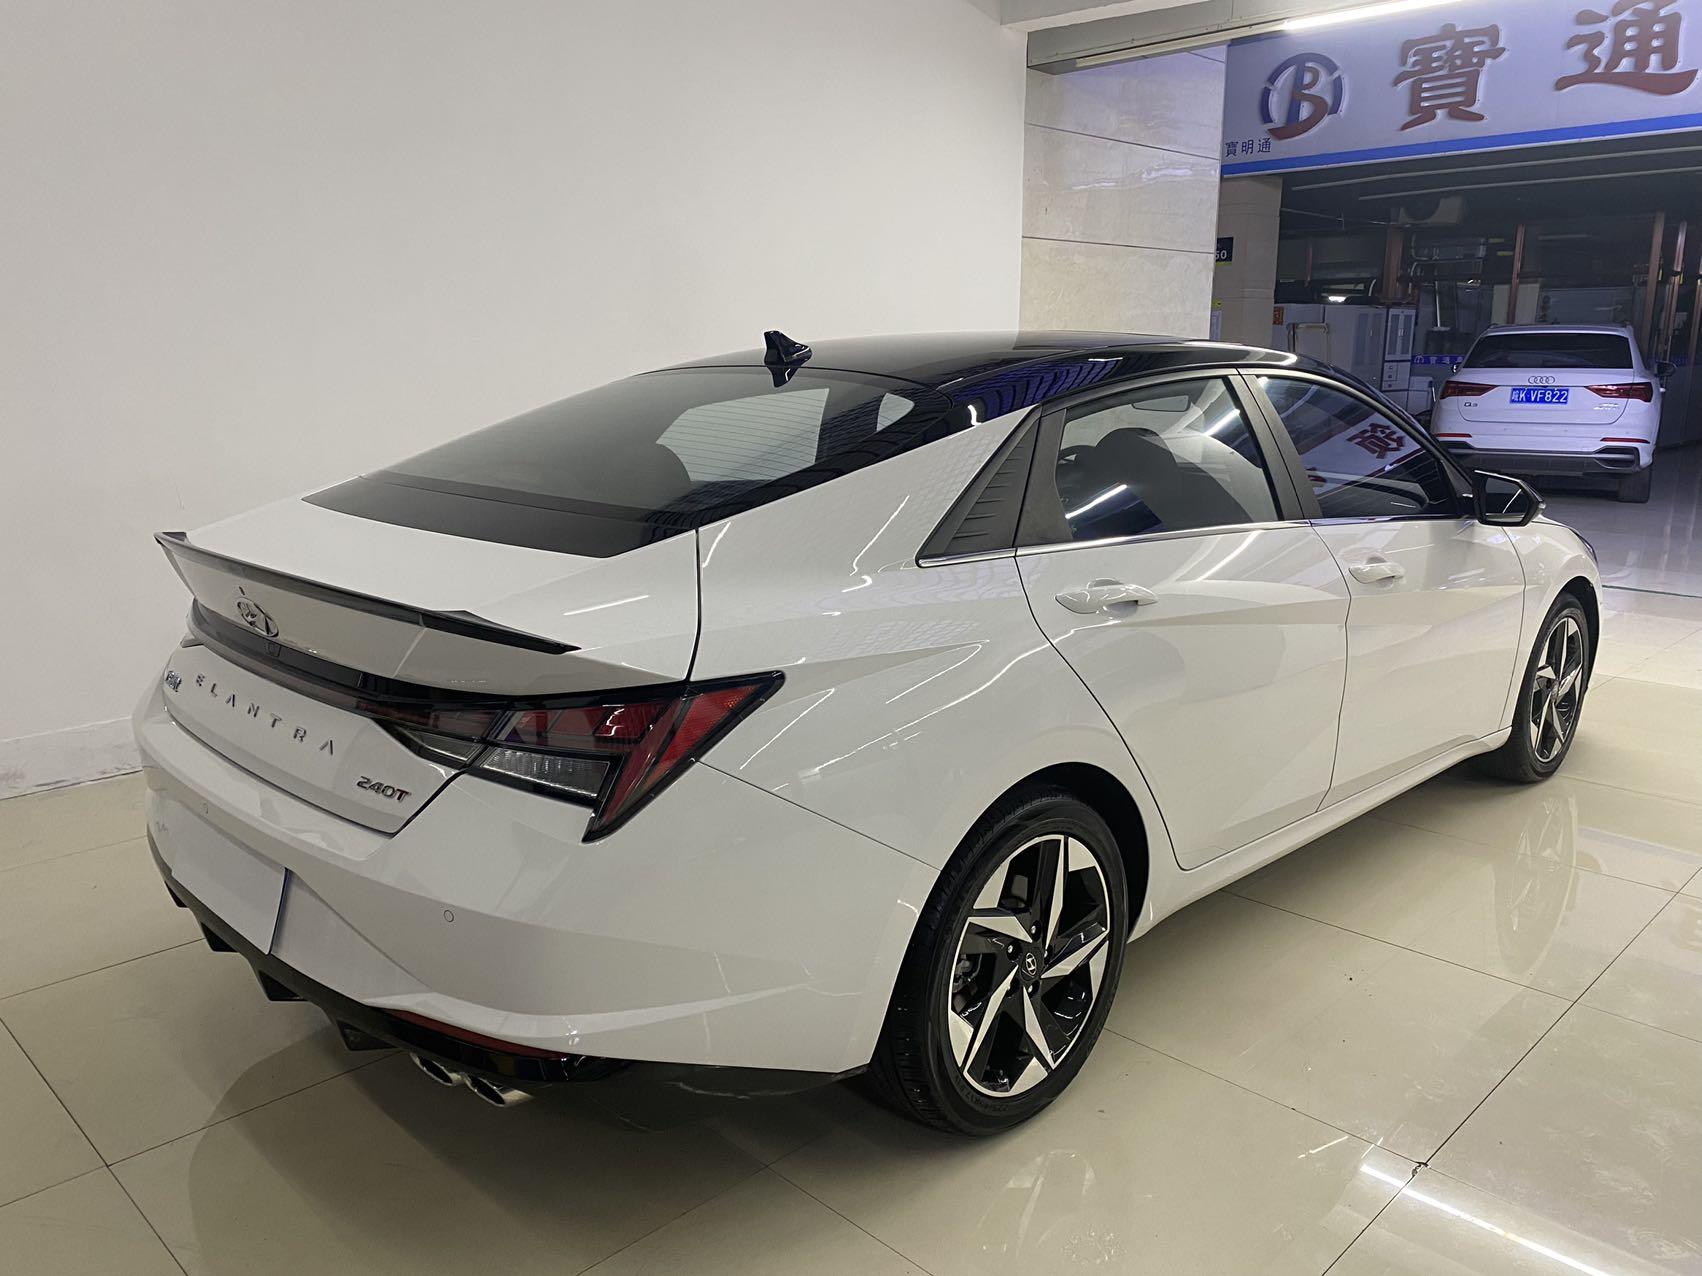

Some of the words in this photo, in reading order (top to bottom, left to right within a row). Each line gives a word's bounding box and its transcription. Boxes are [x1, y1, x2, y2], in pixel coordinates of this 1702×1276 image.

[1224, 137, 1271, 157] 寶明通
[196, 674, 334, 756] ELANTRA
[356, 775, 412, 803] 240T
